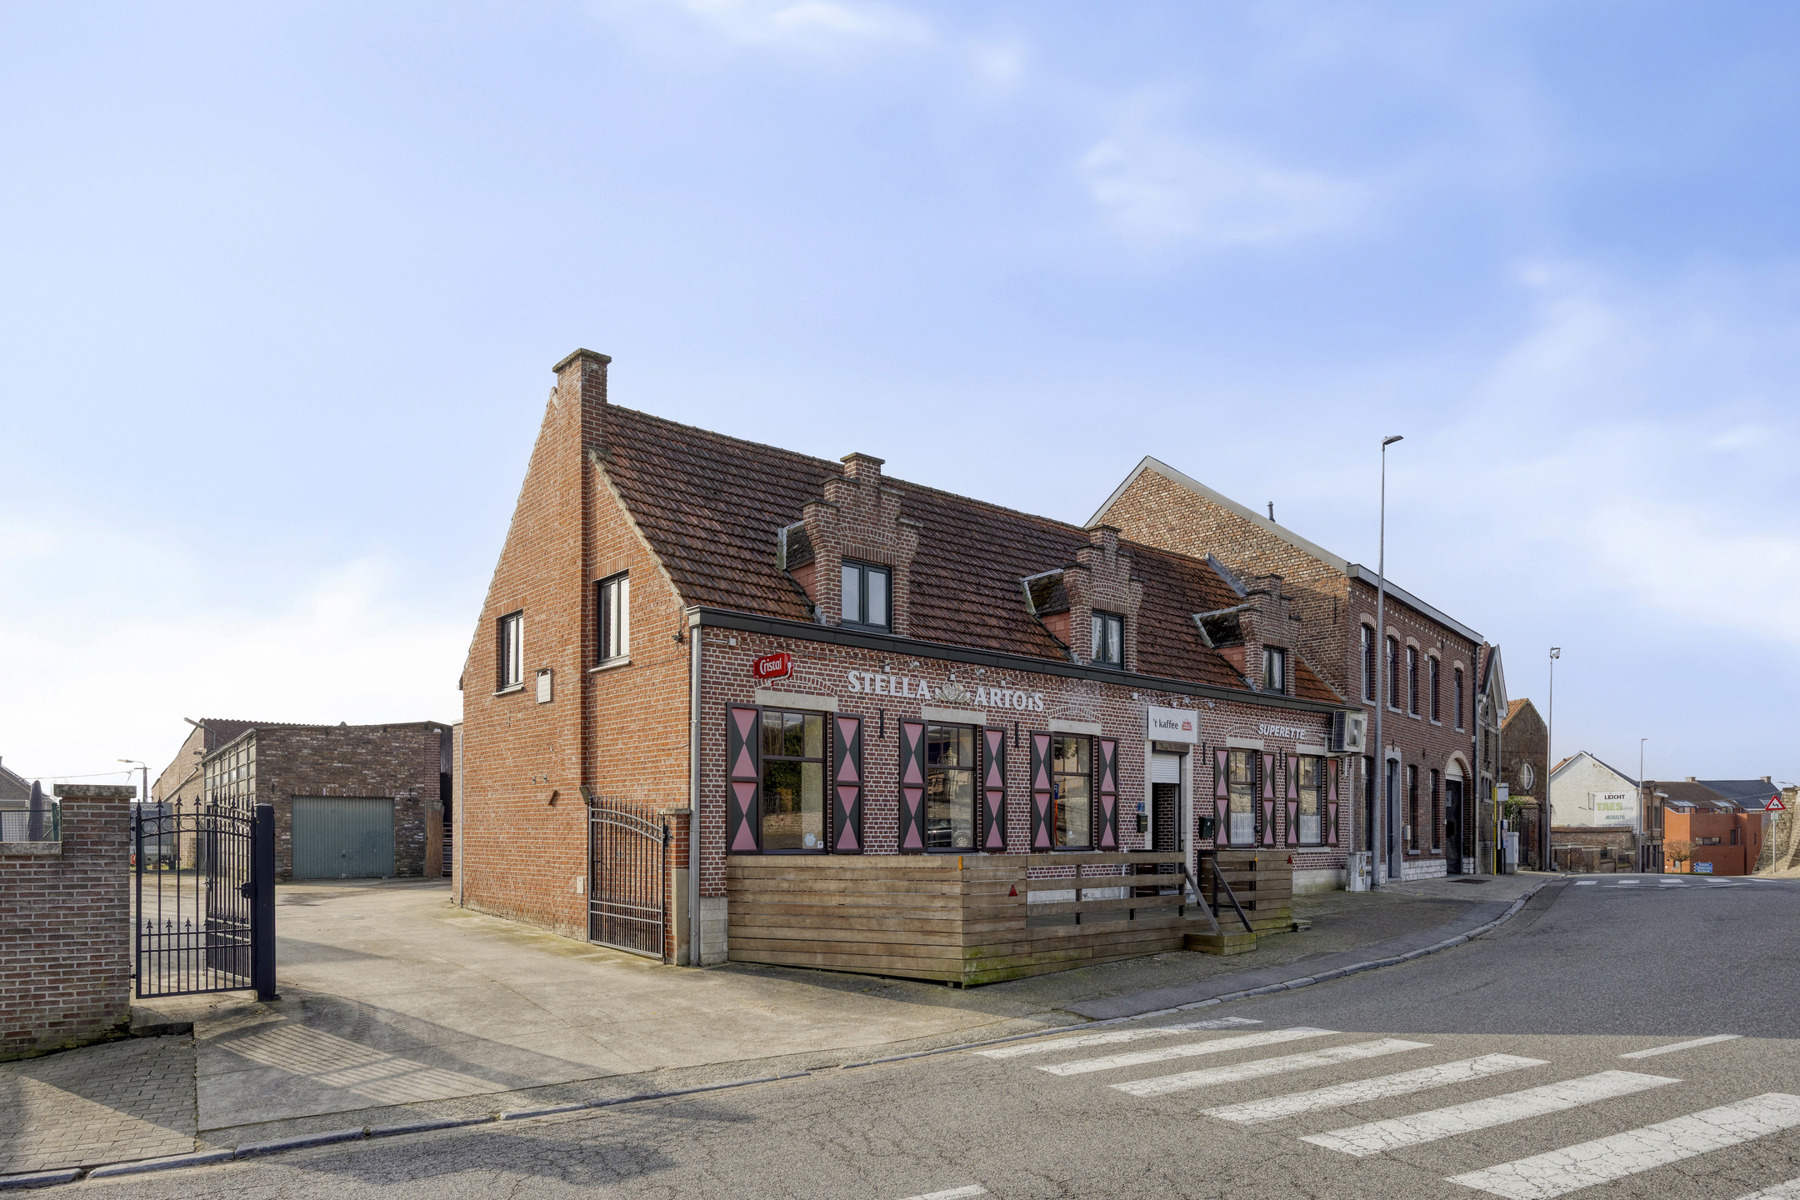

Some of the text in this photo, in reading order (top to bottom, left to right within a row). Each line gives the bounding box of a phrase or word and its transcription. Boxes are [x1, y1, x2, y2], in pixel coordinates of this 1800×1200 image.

[760, 657, 782, 675] Cristal
[848, 670, 1044, 712] STELLA ARTOIS
[1158, 718, 1179, 730] kaffee
[1258, 724, 1305, 739] SUPERETTE
[1596, 802, 1623, 811] TAES
